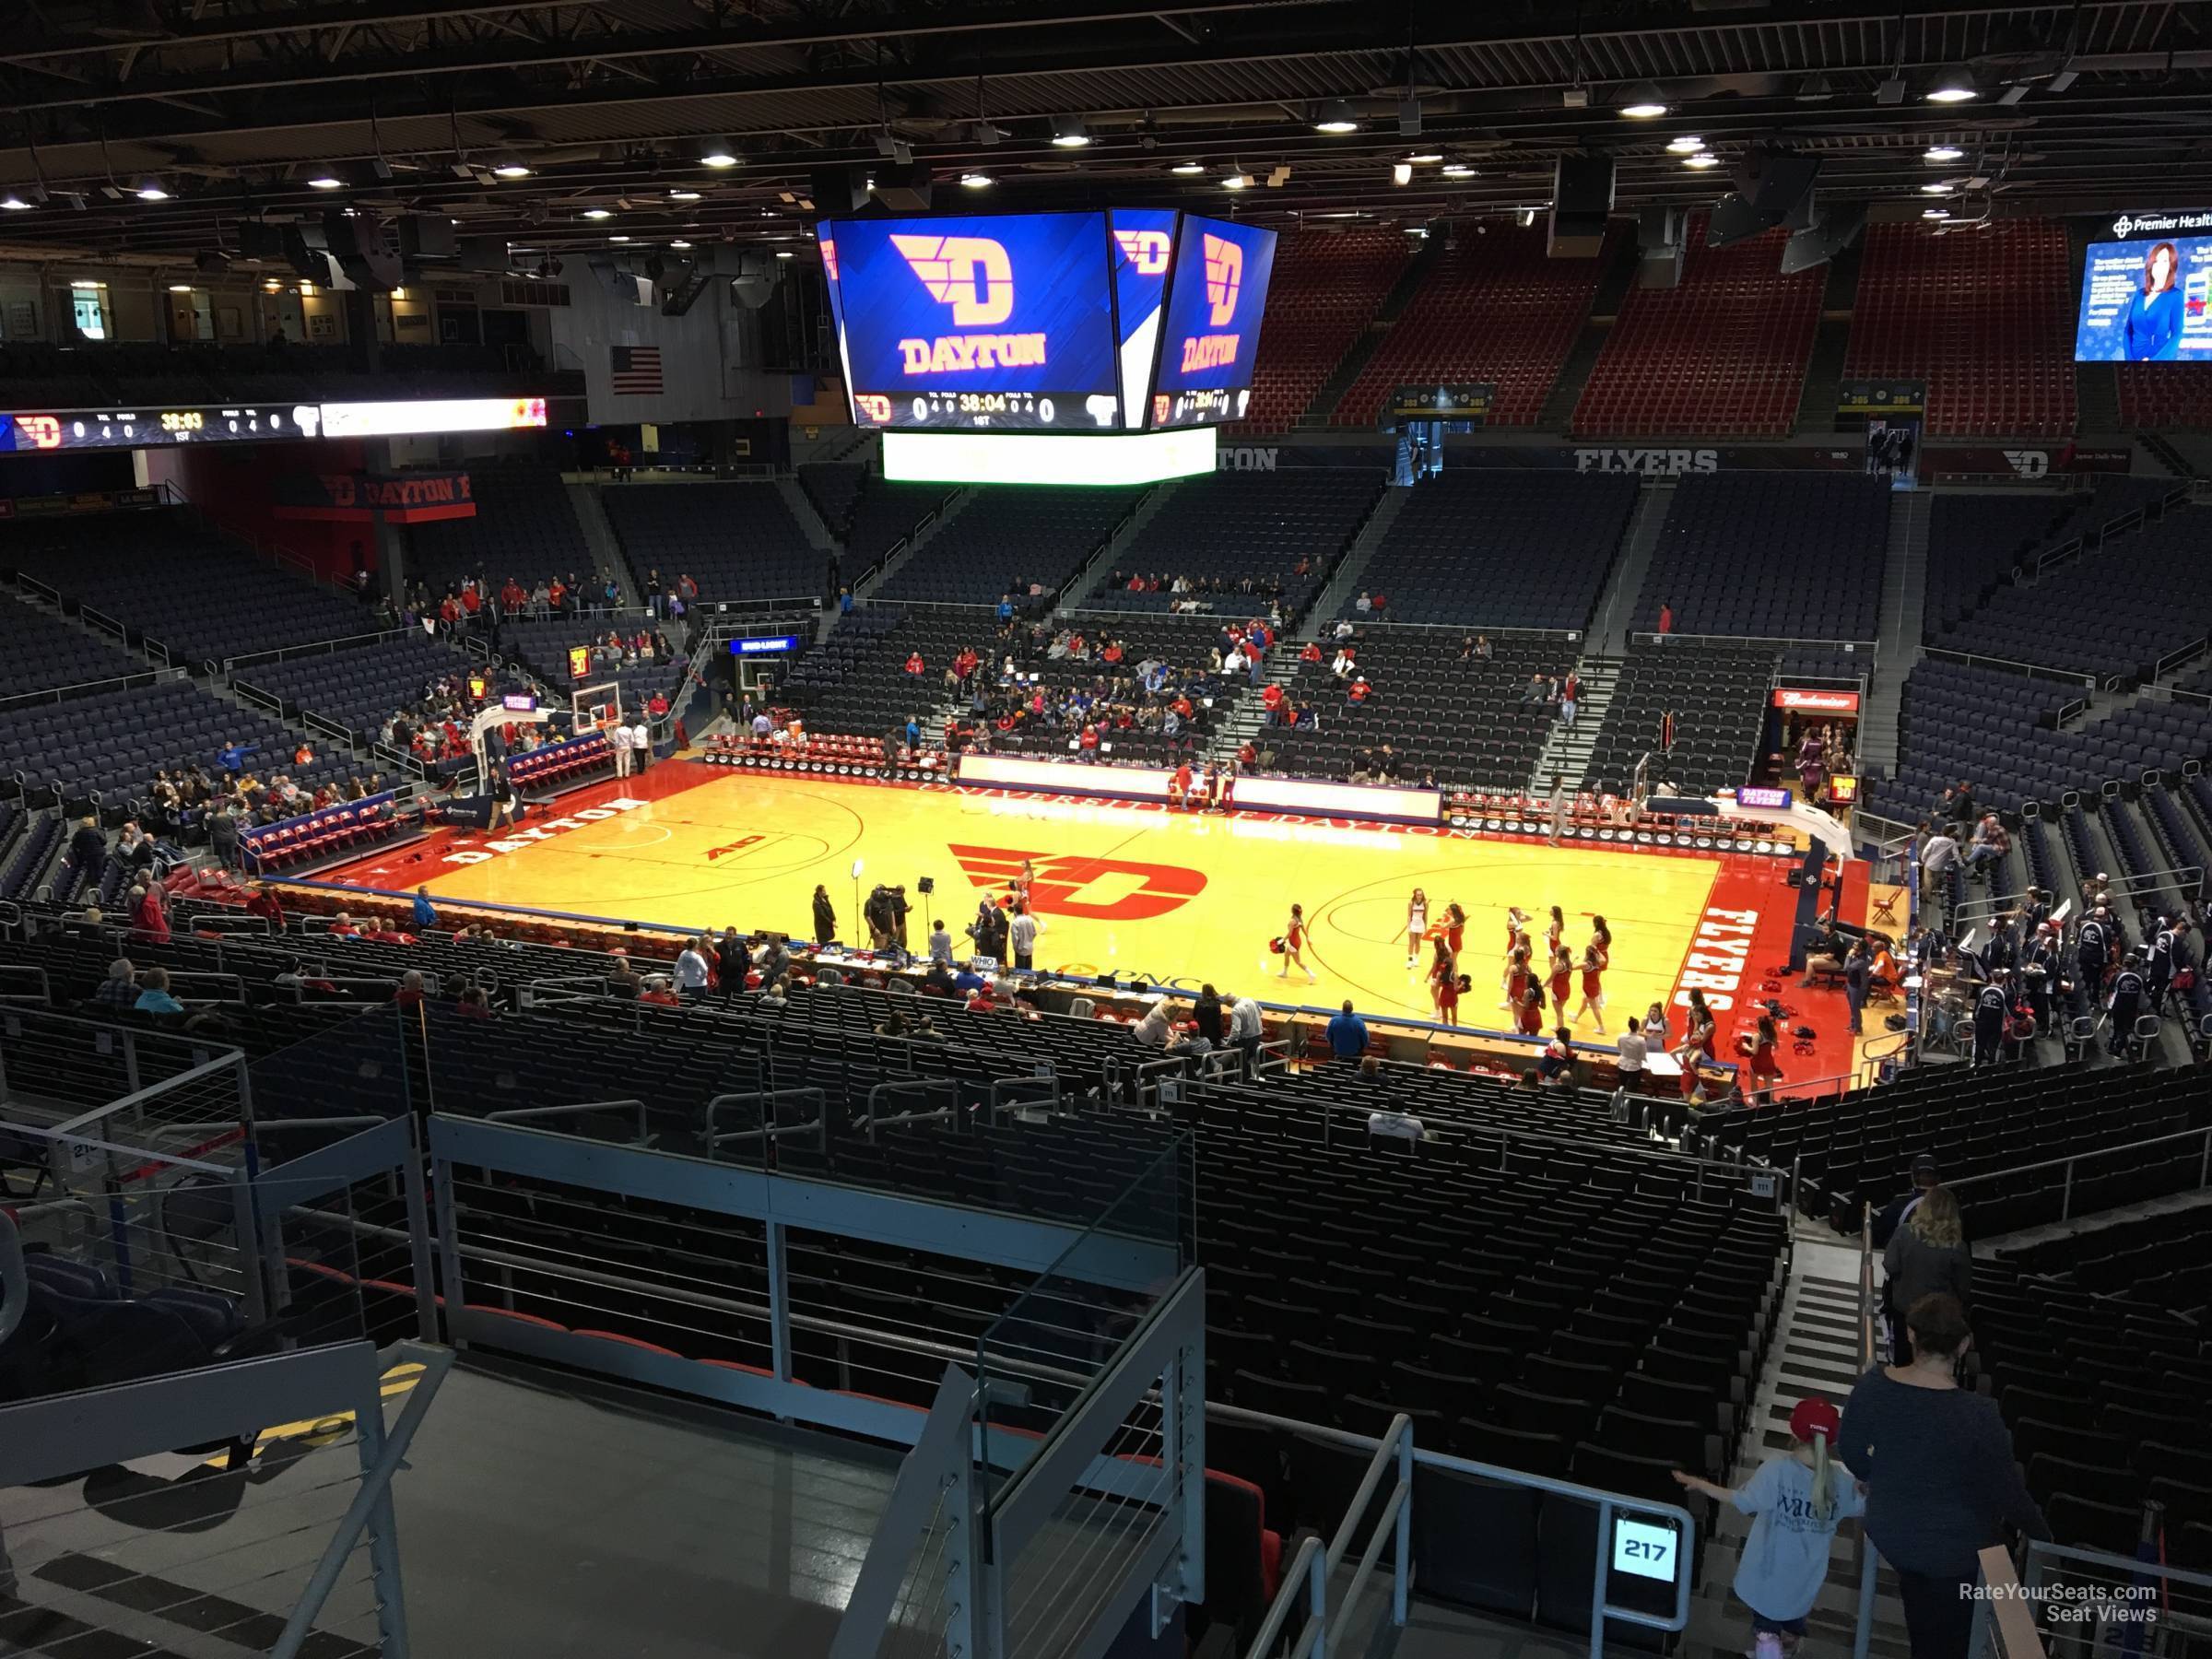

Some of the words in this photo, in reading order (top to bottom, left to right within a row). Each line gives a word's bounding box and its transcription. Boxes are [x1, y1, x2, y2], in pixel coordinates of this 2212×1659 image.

[2135, 217, 2177, 231] Premier
[2179, 214, 2212, 229] Healt
[898, 333, 1047, 374] DAYTON
[1181, 335, 1240, 373] DAYTON
[912, 397, 927, 420] 0
[931, 401, 939, 412] 4
[946, 401, 954, 412] 0
[959, 394, 1006, 411] 38:04
[1010, 401, 1018, 412] 0
[1025, 401, 1033, 412] 4
[1039, 399, 1054, 422] 0
[229, 420, 238, 433] 0
[249, 419, 257, 432] 4
[973, 416, 990, 426] 1ST
[101, 426, 111, 439] 4
[124, 424, 133, 438] 0
[174, 430, 190, 441] 1ST
[1216, 448, 1278, 470] TON
[1573, 449, 1718, 474] FLYERS
[364, 477, 453, 503] DAYTON
[572, 659, 586, 675] 30
[1783, 692, 1850, 707] Budweiser
[1742, 788, 1786, 797] DAYTON
[1742, 796, 1783, 806] FLYERS
[1836, 787, 1852, 799] 30
[441, 797, 651, 864] DAYTON
[1268, 813, 1476, 840] DAYTON
[971, 956, 994, 966] WHIO
[1674, 907, 1759, 1010] FLYERS
[1108, 969, 1203, 990] PNC
[1624, 1539, 1667, 1561] 217
